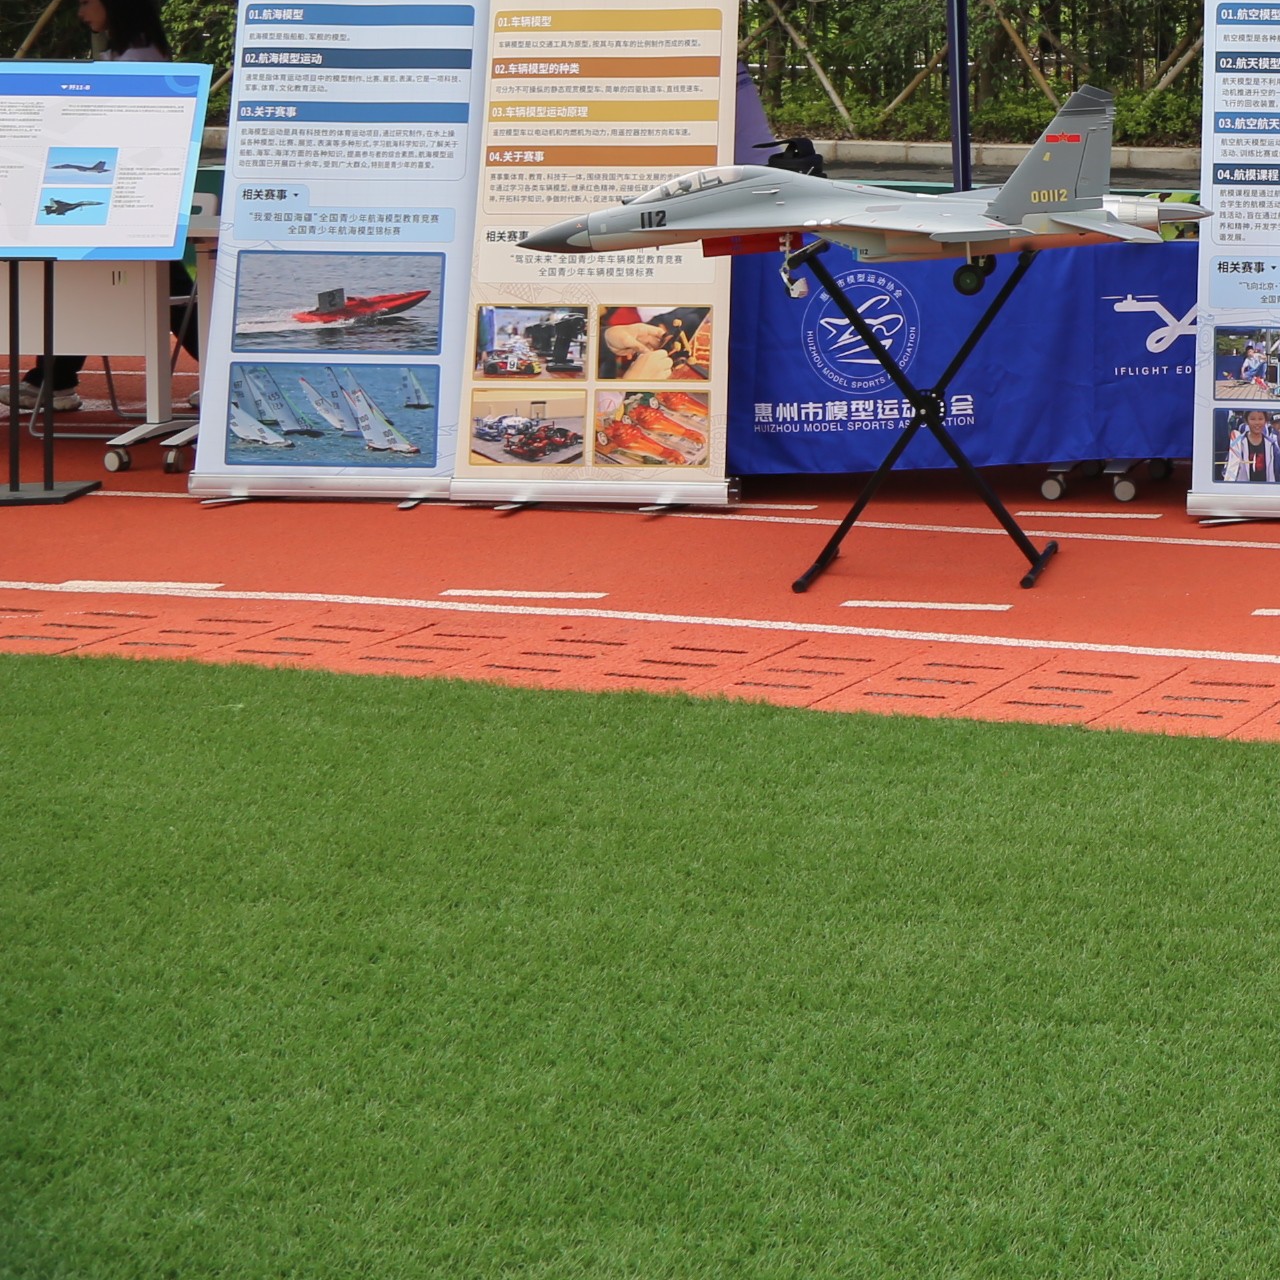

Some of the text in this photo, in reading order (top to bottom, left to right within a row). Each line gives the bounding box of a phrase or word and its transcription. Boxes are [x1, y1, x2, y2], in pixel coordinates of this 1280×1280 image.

[249, 9, 303, 20] 01.航海模型
[498, 16, 552, 28] 01.车辆模型
[245, 53, 323, 64] 02.航海模型运动
[1220, 58, 1280, 69] 02.航天模型
[495, 63, 580, 75] 02.车辆模型的种类
[241, 106, 297, 117] 03.关于赛事
[492, 106, 588, 118] 03.车辆模型运动原理
[489, 151, 544, 162] 04.关于赛事
[1217, 169, 1279, 180] 04.航模课程
[242, 189, 287, 200] 相关赛事
[1031, 189, 1067, 203] 00112
[641, 210, 667, 229] 112
[288, 225, 401, 235] 全国青少年航海模型锦标赛
[539, 267, 654, 277] 全国青少年车辆模型锦标赛
[1217, 262, 1265, 274] 相关赛事
[807, 331, 823, 369] HUIZHOU
[822, 368, 848, 387] MODEL
[851, 377, 886, 389] SPORTS
[1115, 367, 1168, 375] IFLIGHT
[754, 395, 974, 422] 惠州市模型运动会
[754, 424, 800, 433] HUIZHOU
[804, 423, 843, 432] MODEL
[847, 422, 894, 431] SPORTS
